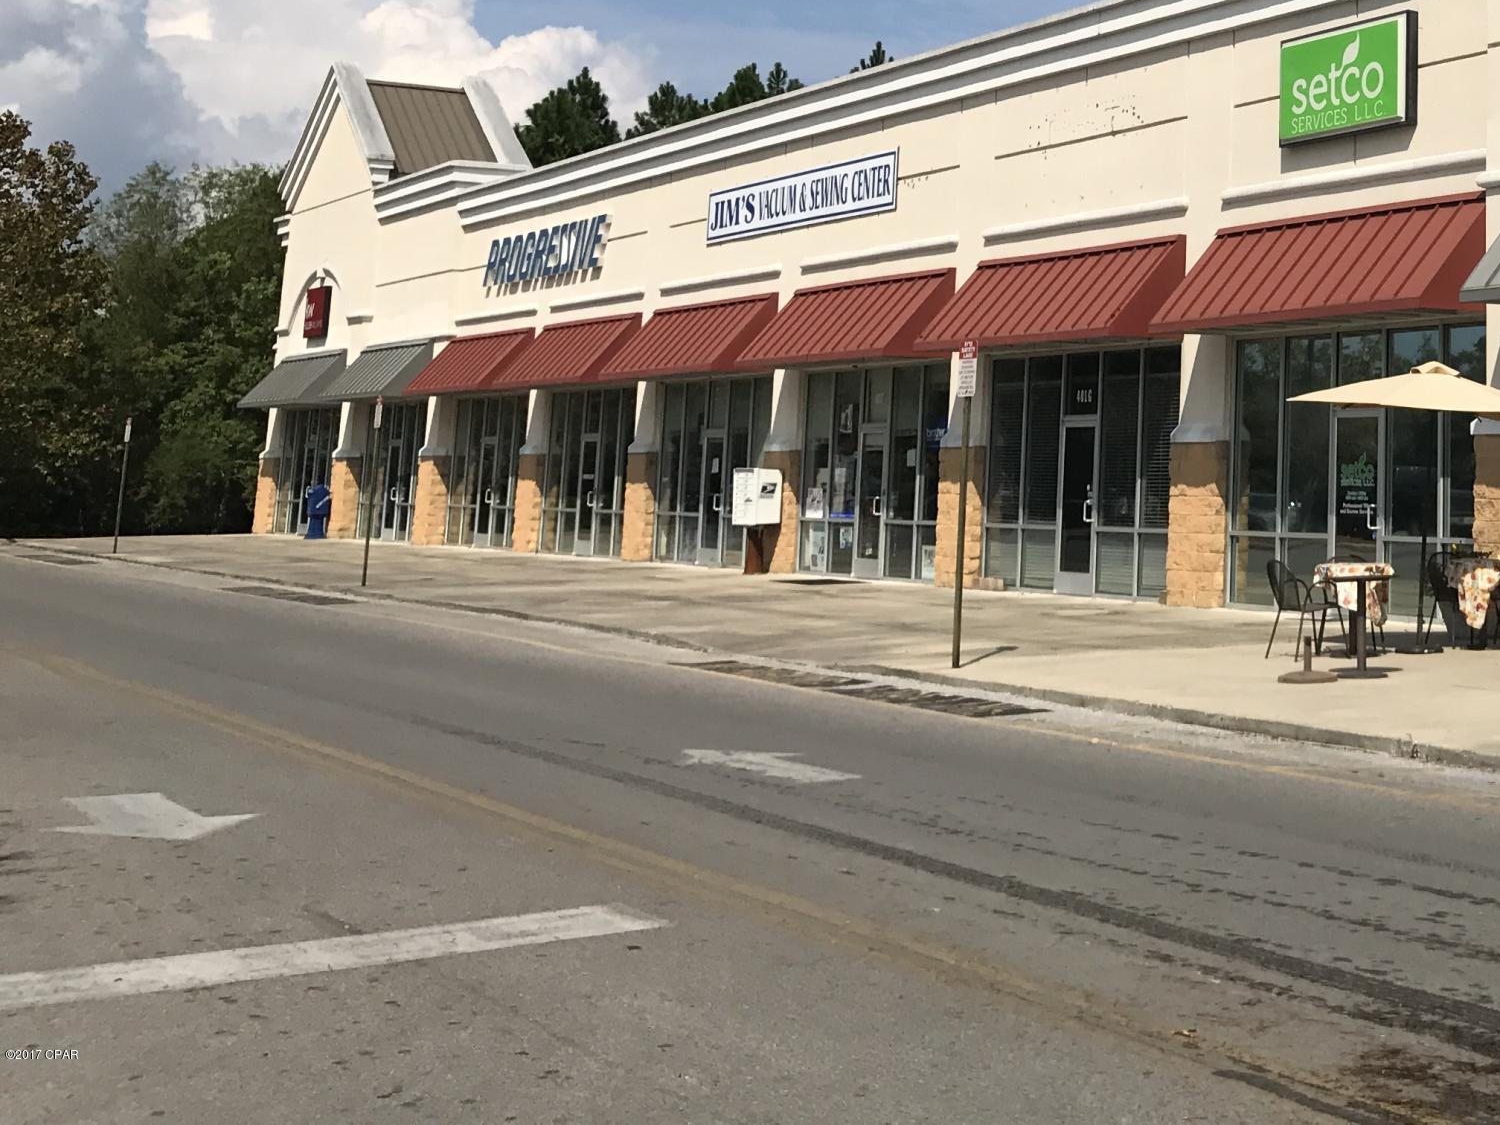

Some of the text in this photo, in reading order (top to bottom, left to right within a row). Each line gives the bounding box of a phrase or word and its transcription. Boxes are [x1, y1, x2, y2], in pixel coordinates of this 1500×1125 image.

[1291, 60, 1384, 115] setco
[1291, 107, 1348, 135] SERVICES
[710, 164, 891, 231] JIM'S VACUUM & SEWING CENTER
[482, 213, 610, 287] PROGRESSIVE
